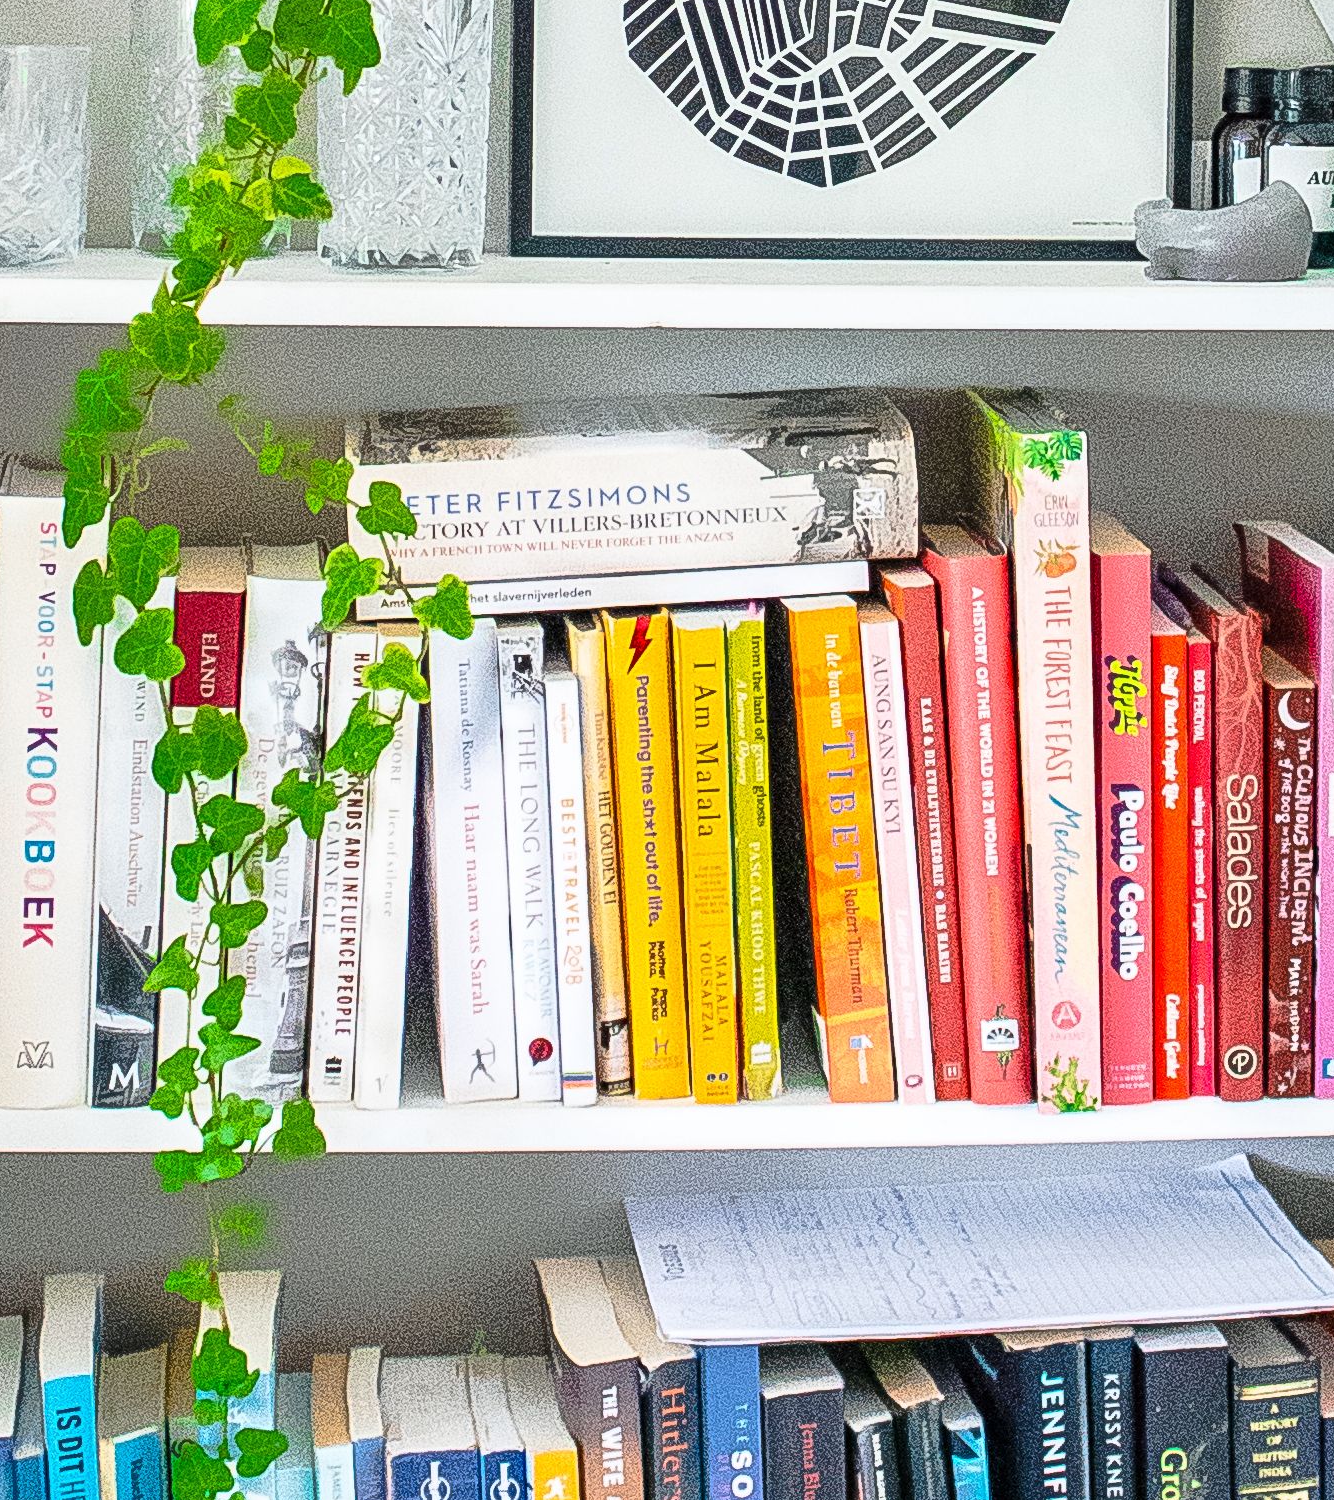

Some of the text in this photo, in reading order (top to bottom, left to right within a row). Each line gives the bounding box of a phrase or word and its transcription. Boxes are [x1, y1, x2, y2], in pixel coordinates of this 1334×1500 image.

[406, 483, 691, 516] ETER FITZSIMONS
[497, 505, 788, 537] AT VILLERS-BRETONNEUX
[1033, 511, 1080, 528] GLEESON
[432, 531, 735, 558] FRENCH TOWN WILL NEVER FORGET THE ANZACS
[492, 588, 593, 605] slavernijverleden
[971, 600, 989, 666] HISTORY
[695, 684, 718, 730] Am
[975, 667, 990, 688] OF
[976, 689, 992, 719] THE
[751, 696, 769, 828] land ghosts
[870, 653, 902, 835] AUNG SAN SU KYI
[979, 723, 995, 777] WORLD
[635, 676, 663, 892] Parenting the out of
[695, 743, 722, 837] Malala
[822, 730, 862, 879] TIBET
[1044, 586, 1084, 984] THE FOREST FEAST Mediterranean
[23, 727, 59, 948] KOOKBOEK
[125, 739, 149, 908] Eindstation Auschwitz
[457, 659, 491, 1015] Tatiana de Haar naam was Sarah
[517, 723, 545, 929] THE LONG WALK
[598, 790, 617, 886] HET GOUDEN
[983, 817, 1000, 876] WOMEN
[1225, 773, 1259, 929] Salades
[560, 798, 585, 986] BEST TRAVEL 2018
[1117, 789, 1145, 981] Paulo Coelho
[335, 836, 361, 1036] AND INFLUENCE PEOPLE
[844, 888, 866, 1004] Robert Thurman
[698, 939, 716, 1042] YOUSAFZAI
[56, 1405, 82, 1431] IS
[601, 1386, 618, 1418] THE
[1103, 1372, 1121, 1448] KRISSY
[1249, 1415, 1298, 1432] HISTORY
[58, 1437, 86, 1476] DIT
[602, 1425, 626, 1487] WIFE
[798, 1423, 818, 1470] Jenna
